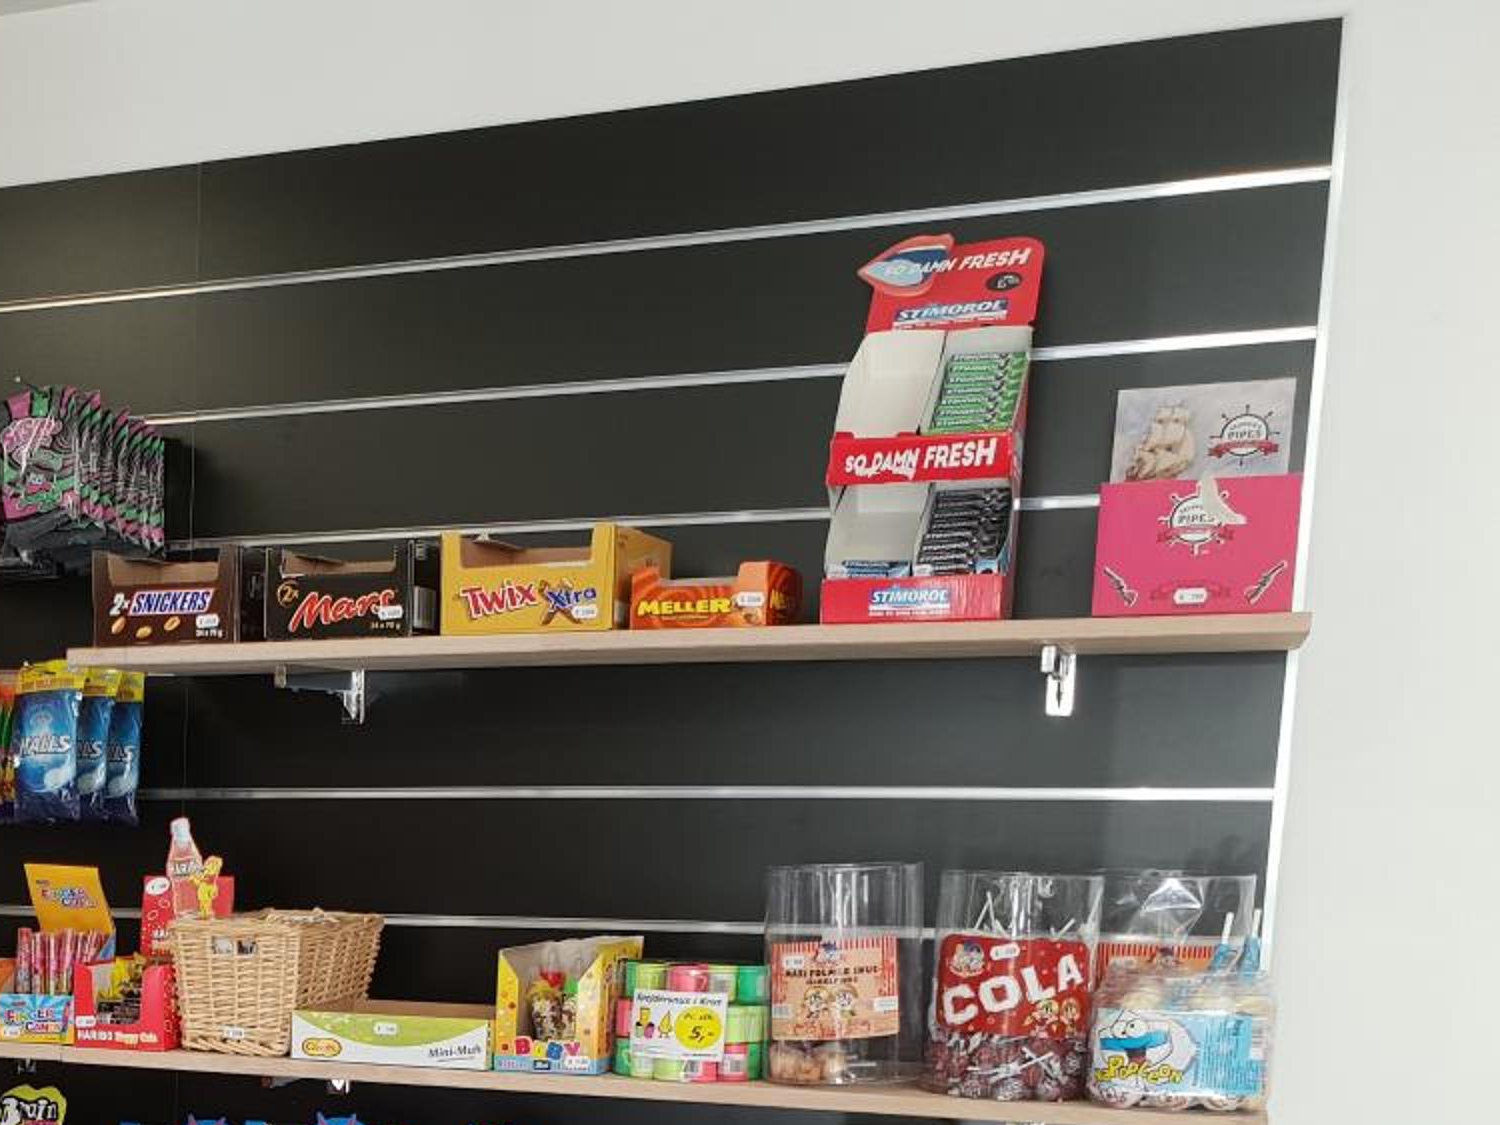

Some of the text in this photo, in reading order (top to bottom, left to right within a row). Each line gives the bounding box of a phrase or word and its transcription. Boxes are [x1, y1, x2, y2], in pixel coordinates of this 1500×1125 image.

[959, 248, 1032, 271] FRESH
[897, 299, 1008, 320] STIMOROL
[871, 447, 920, 473] DAMN
[923, 438, 997, 468] FRESH
[132, 590, 212, 614] SNICKERS
[459, 581, 538, 619] Twix
[637, 597, 732, 616] MELLER
[871, 587, 949, 604] STIMOROL
[288, 590, 395, 632] Mars
[943, 953, 1084, 1025] COLA
